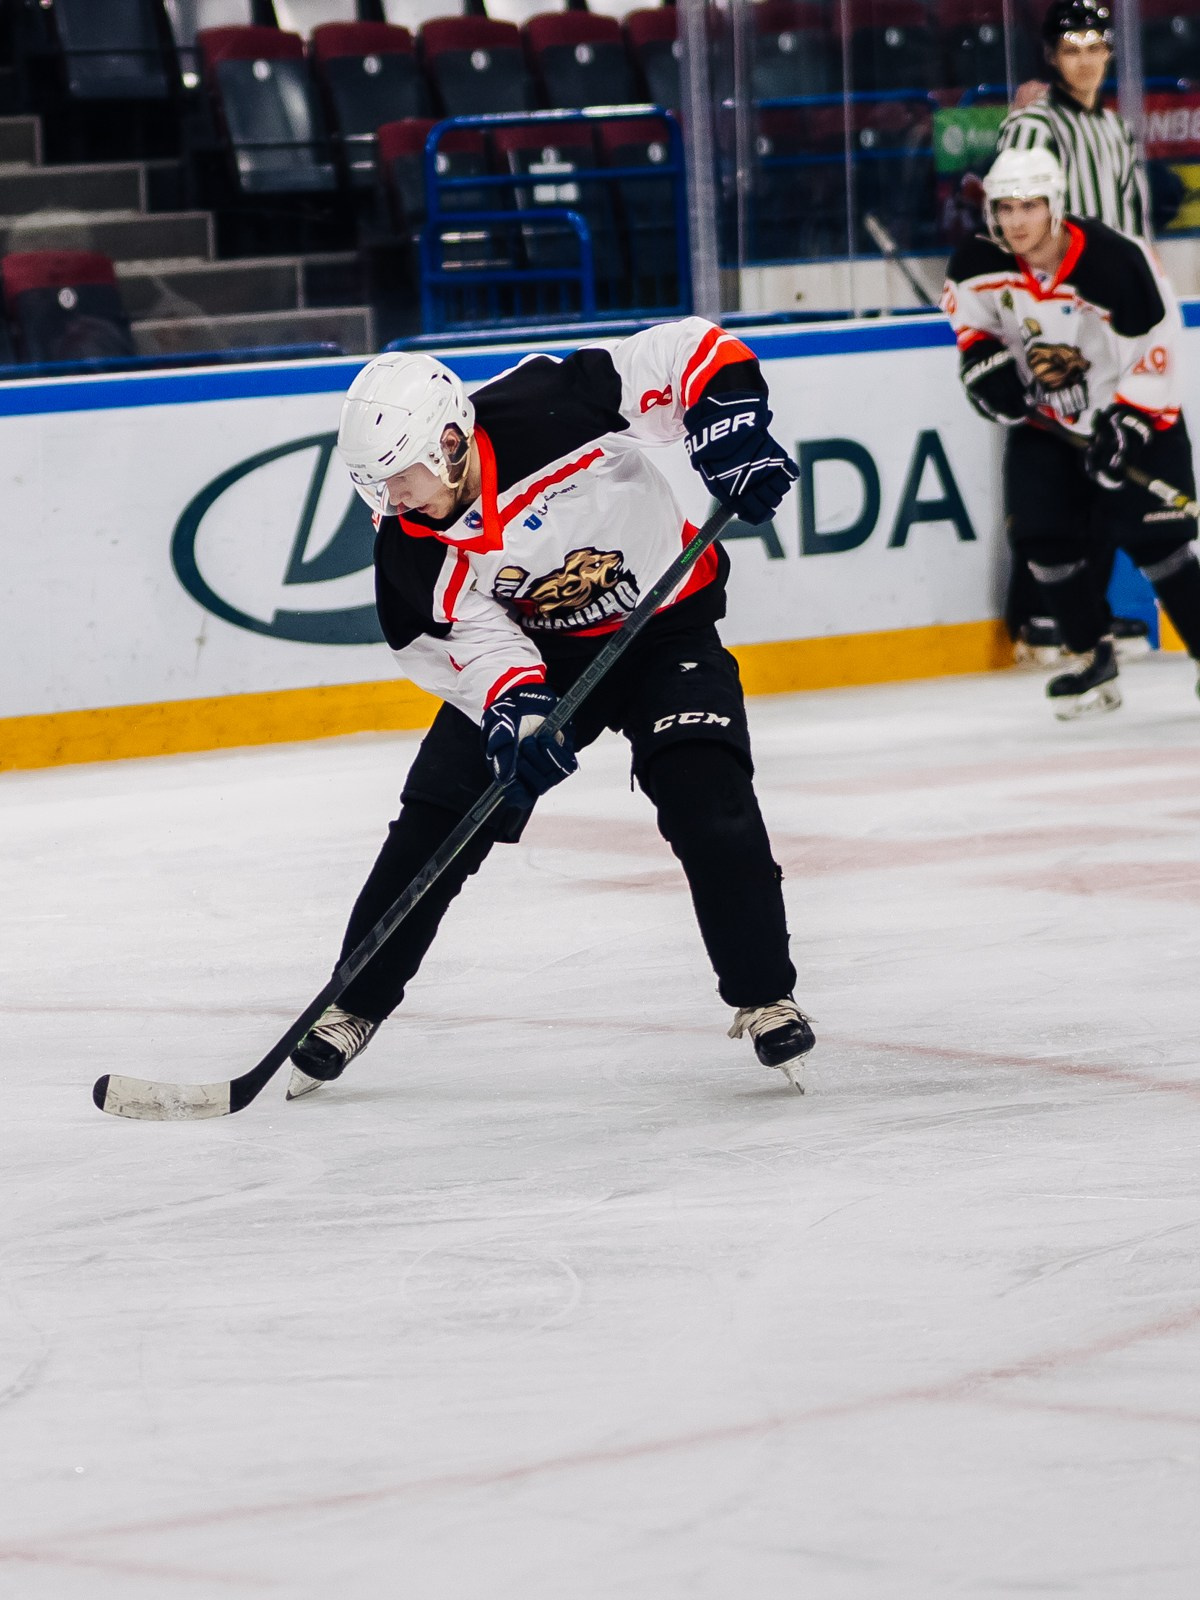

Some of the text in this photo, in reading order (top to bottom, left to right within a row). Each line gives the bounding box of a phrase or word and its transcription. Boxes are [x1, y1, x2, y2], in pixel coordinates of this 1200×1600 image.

[684, 411, 757, 456] AUER
[707, 428, 978, 561] ADA
[653, 711, 731, 733] CCM
